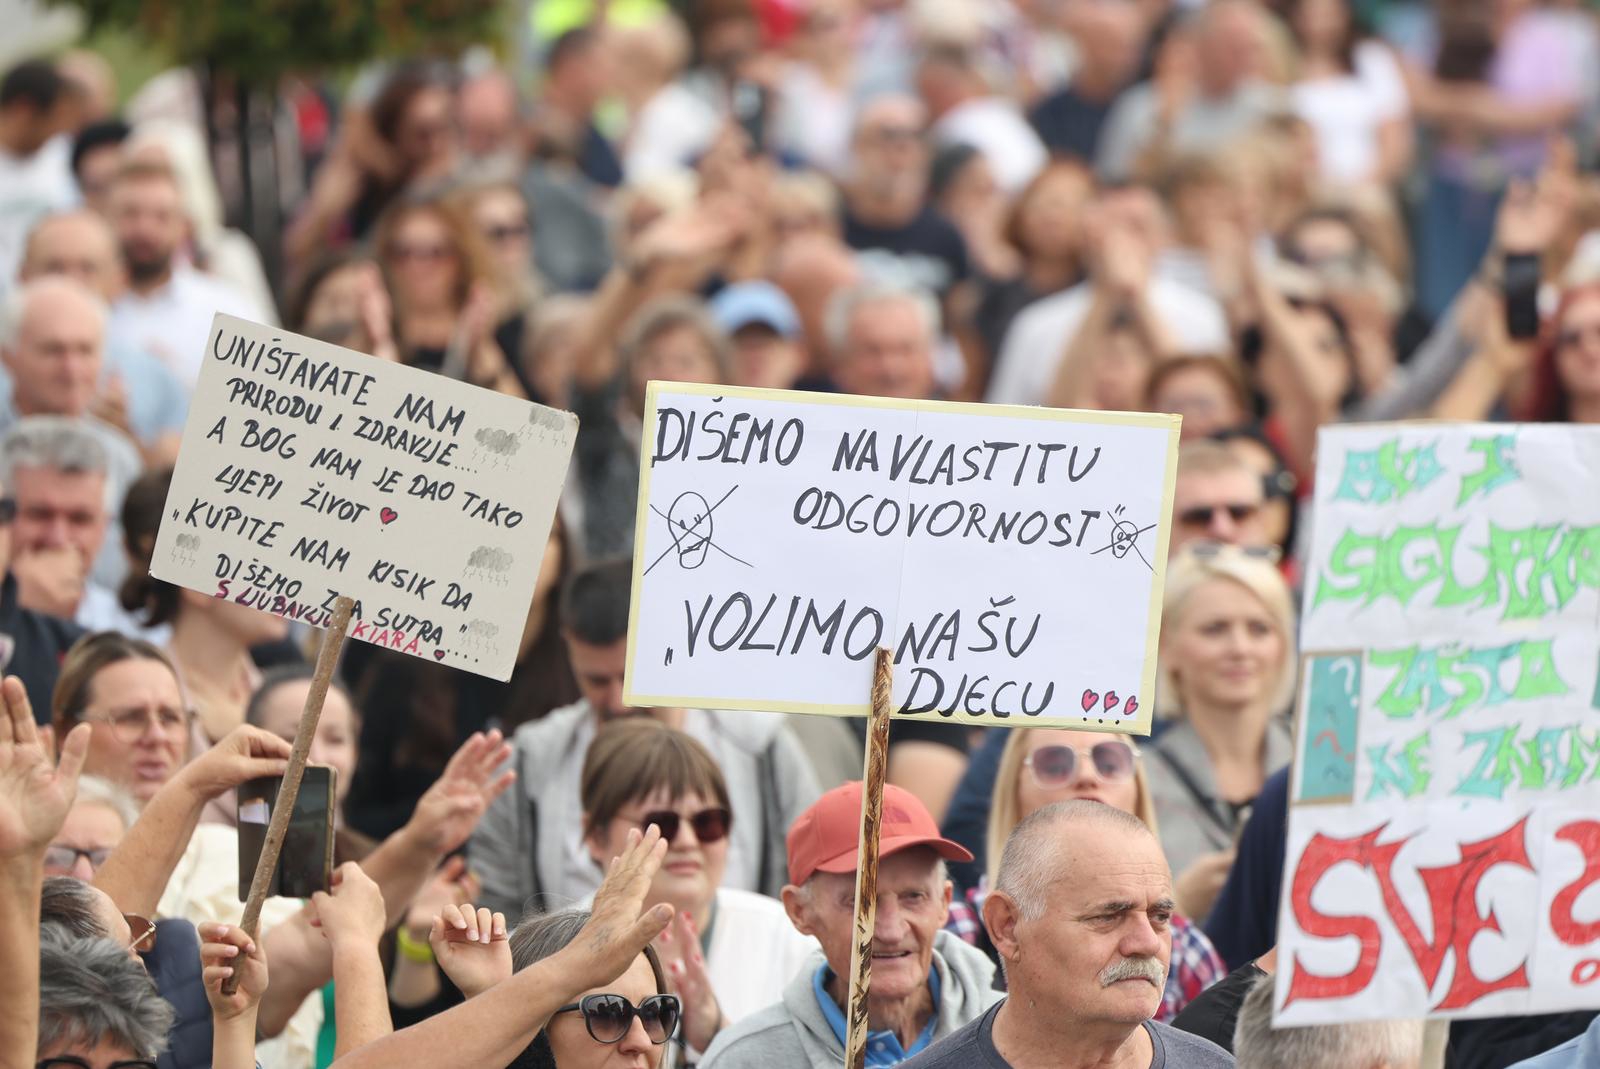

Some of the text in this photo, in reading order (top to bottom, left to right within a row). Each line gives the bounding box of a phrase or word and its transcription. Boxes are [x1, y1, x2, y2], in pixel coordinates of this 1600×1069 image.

[214, 329, 466, 437] UNIŠTAVATE NAM
[226, 377, 323, 424] PRIRODU
[651, 396, 804, 468] DIŠEMO
[206, 416, 523, 528] A BOG NAM JE DAO TAKO
[300, 481, 370, 523] ŽIVOT
[793, 486, 1101, 548] ODGOVORNOST
[214, 579, 231, 599] S
[215, 553, 302, 598] DIŠEMO
[290, 537, 350, 572] NAM
[368, 560, 436, 600] KISIK
[441, 583, 473, 611] DA
[893, 595, 1041, 665] NAŠU
[897, 666, 1055, 718] DJECU
